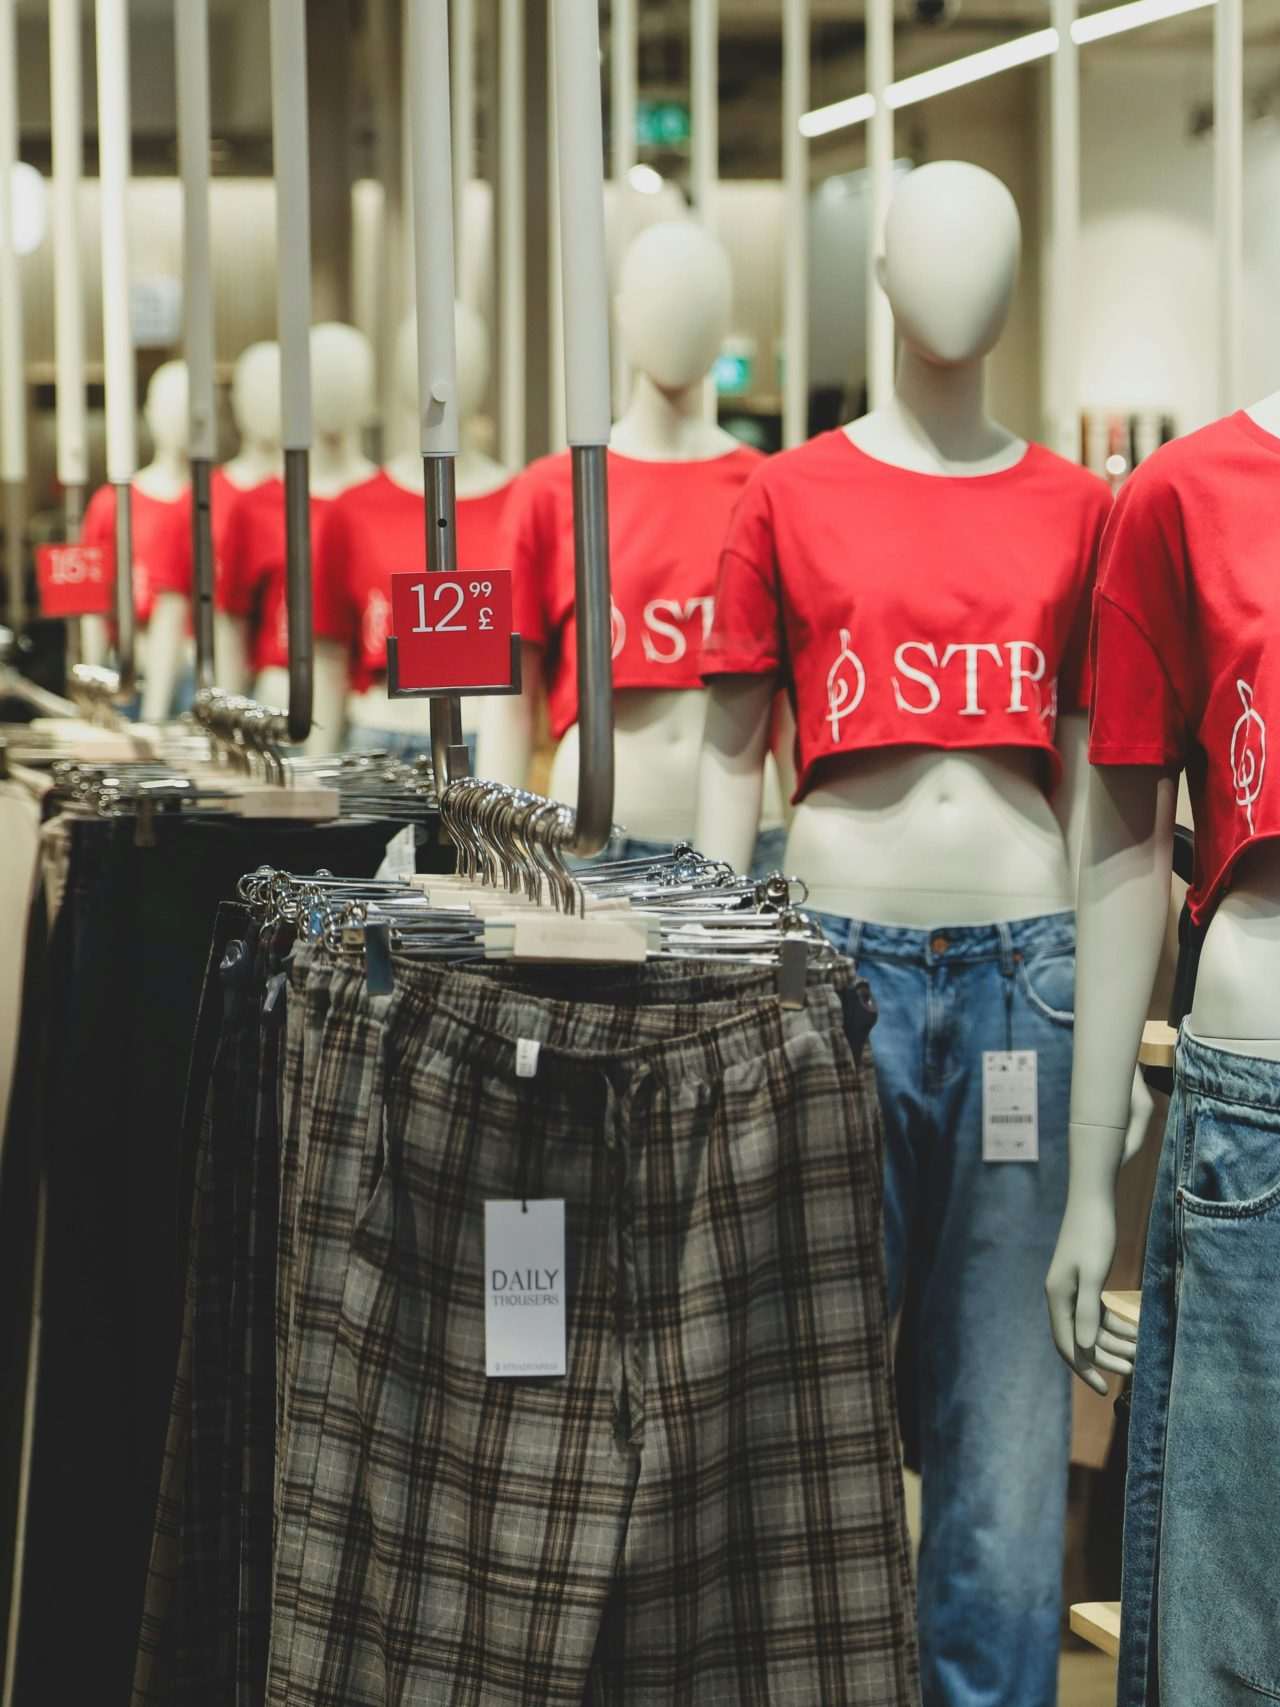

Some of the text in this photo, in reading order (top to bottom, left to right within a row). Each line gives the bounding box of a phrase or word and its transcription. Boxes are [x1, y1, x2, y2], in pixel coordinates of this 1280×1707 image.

[410, 581, 492, 633] 12 99
[478, 607, 494, 630] £
[491, 1269, 560, 1291] DAILY
